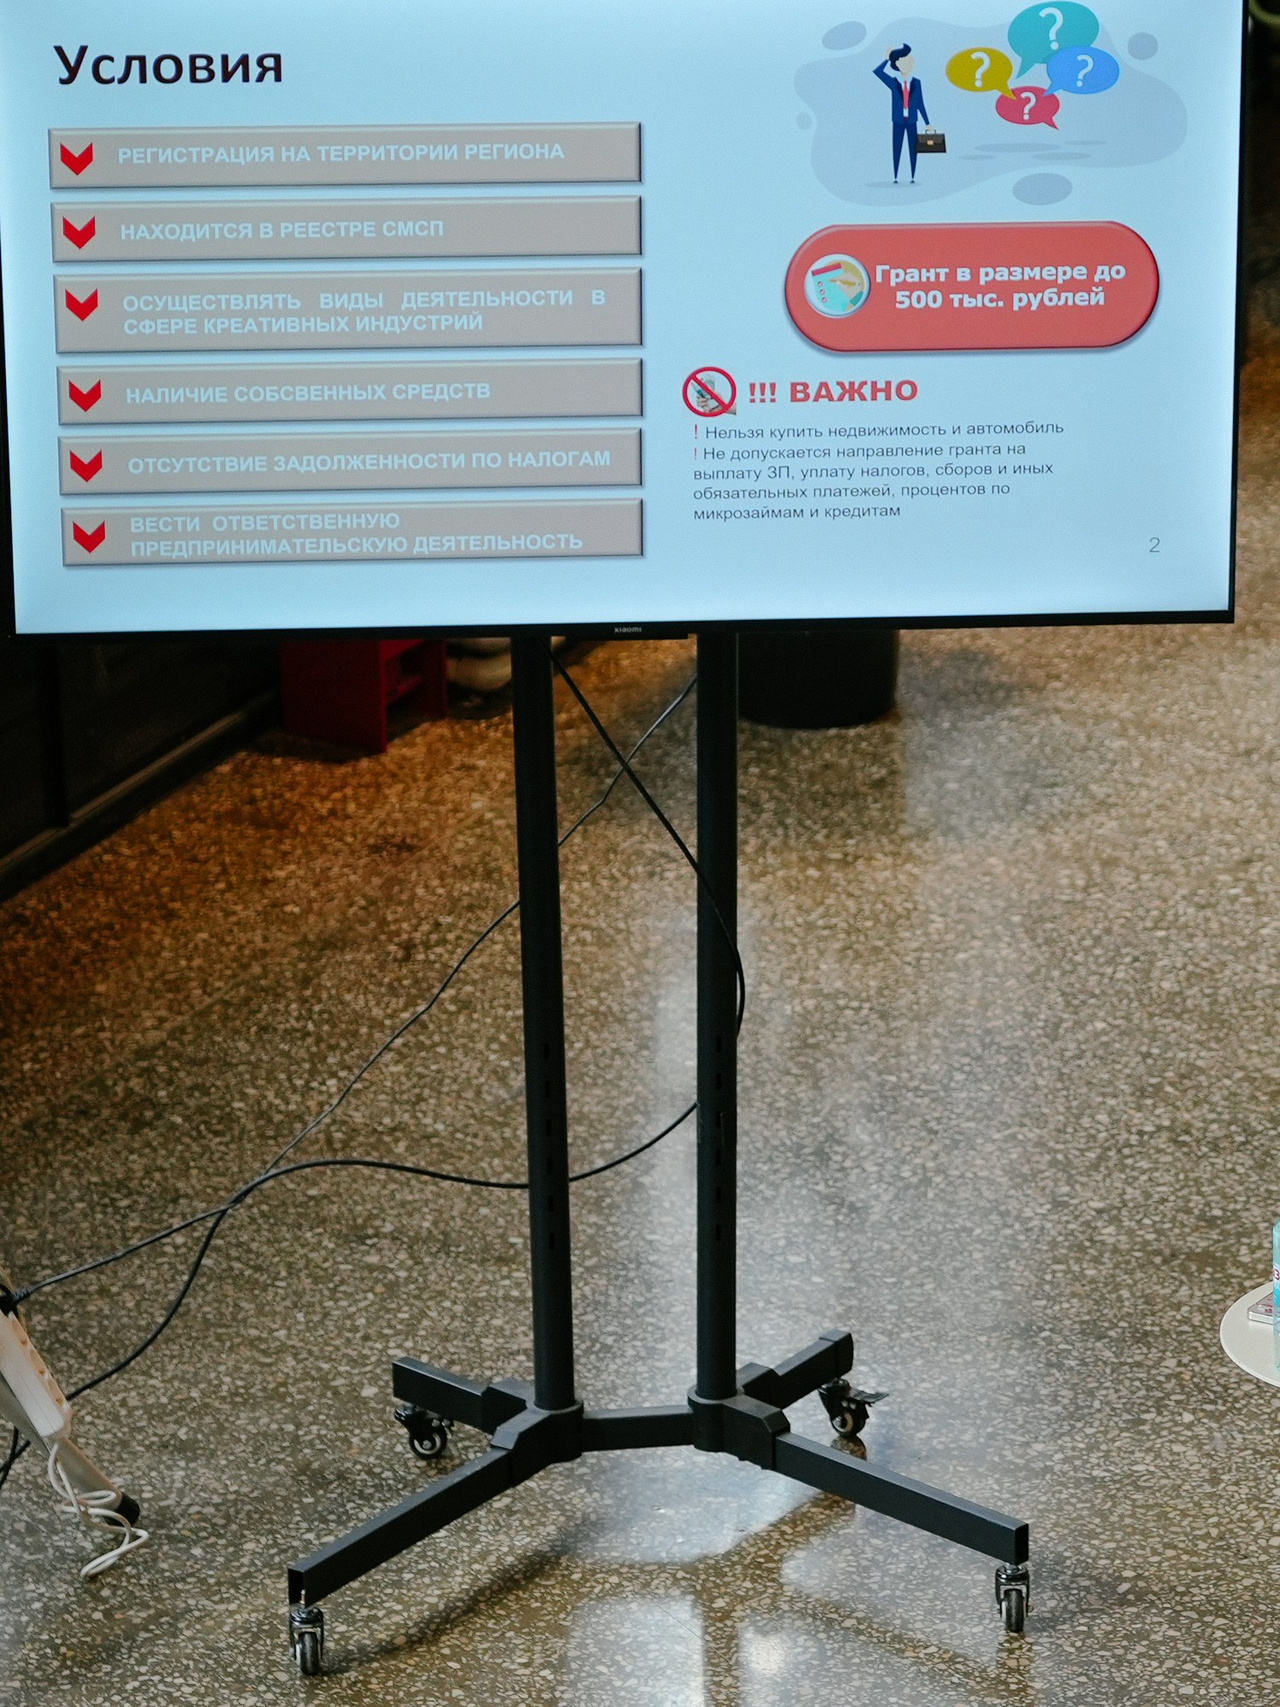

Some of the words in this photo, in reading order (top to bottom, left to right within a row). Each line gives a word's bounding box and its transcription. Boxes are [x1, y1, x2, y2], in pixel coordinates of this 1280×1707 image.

[53, 45, 284, 85] Условия
[118, 147, 275, 166] РЕГИСТРАЦИЯ
[281, 146, 311, 163] НА
[317, 144, 459, 162] ТЕРРИТОРИИ
[465, 143, 566, 160] РЕГИОНА
[120, 223, 253, 242] НАХОДИТСЯ
[260, 223, 274, 238] В
[280, 221, 376, 238] РЕЕСТРЕ
[382, 220, 444, 237] СМСП
[875, 265, 949, 286] Грант
[956, 267, 971, 281] в
[979, 265, 1087, 285] размере
[1093, 264, 1126, 282] до
[122, 294, 301, 313] ОСУЩЕСТВЛЯТЬ
[319, 292, 384, 311] ВИДЫ
[401, 290, 574, 310] ДЕЯТЕЛЬНОСТИ
[591, 289, 606, 306] В
[895, 290, 943, 309] 500
[949, 292, 1004, 308] тыс.
[1012, 286, 1105, 311] рублей
[123, 318, 198, 335] СФЕРЕ
[203, 316, 350, 335] КРЕАТИВНЫХ
[355, 311, 483, 334] ИНДУСТРИЙ
[125, 386, 228, 404] НАЛИЧИЕ
[234, 384, 387, 402] СОБСВЕННЫХ
[392, 382, 491, 402] СРЕДСТВ
[749, 382, 777, 404] !!!
[789, 380, 919, 403] ВАЖНО
[705, 426, 764, 440] Нельзя
[770, 427, 823, 442] купить
[828, 425, 947, 440] недвижимость
[952, 425, 961, 435] и
[966, 421, 1064, 436] автомобиль
[128, 456, 268, 475] ОТСУТСТВИЕ
[273, 452, 466, 473] ЗАДОЛЖЕННОСТИ
[472, 452, 502, 469] ПО
[508, 450, 611, 468] НАЛОГАМ
[703, 447, 726, 461] Не
[730, 447, 831, 463] допускается
[837, 445, 944, 461] направление
[949, 445, 1001, 459] гранта
[1007, 444, 1027, 456] на
[693, 468, 762, 483] выплату
[767, 466, 795, 481] ЗП,
[801, 467, 855, 482] уплату
[860, 466, 930, 479] налогов,
[935, 463, 993, 478] сборов
[998, 464, 1007, 476] и
[1012, 463, 1054, 475] иных
[693, 486, 808, 501] обязательных
[813, 483, 896, 499] платежей,
[901, 485, 986, 499] процентов
[991, 484, 1011, 496] по
[130, 516, 200, 534] ВЕСТИ
[212, 512, 400, 532] ОТВЕТСТВЕННУЮ
[693, 506, 804, 523] микрозаймам
[810, 508, 819, 519] и
[825, 505, 901, 521] кредитам
[131, 536, 408, 559] ПРЕДПРИНИМАТЕЛЬСКУЮ
[413, 533, 584, 555] ДЕЯТЕЛЬНОСТЬ
[1149, 537, 1162, 554] 2
